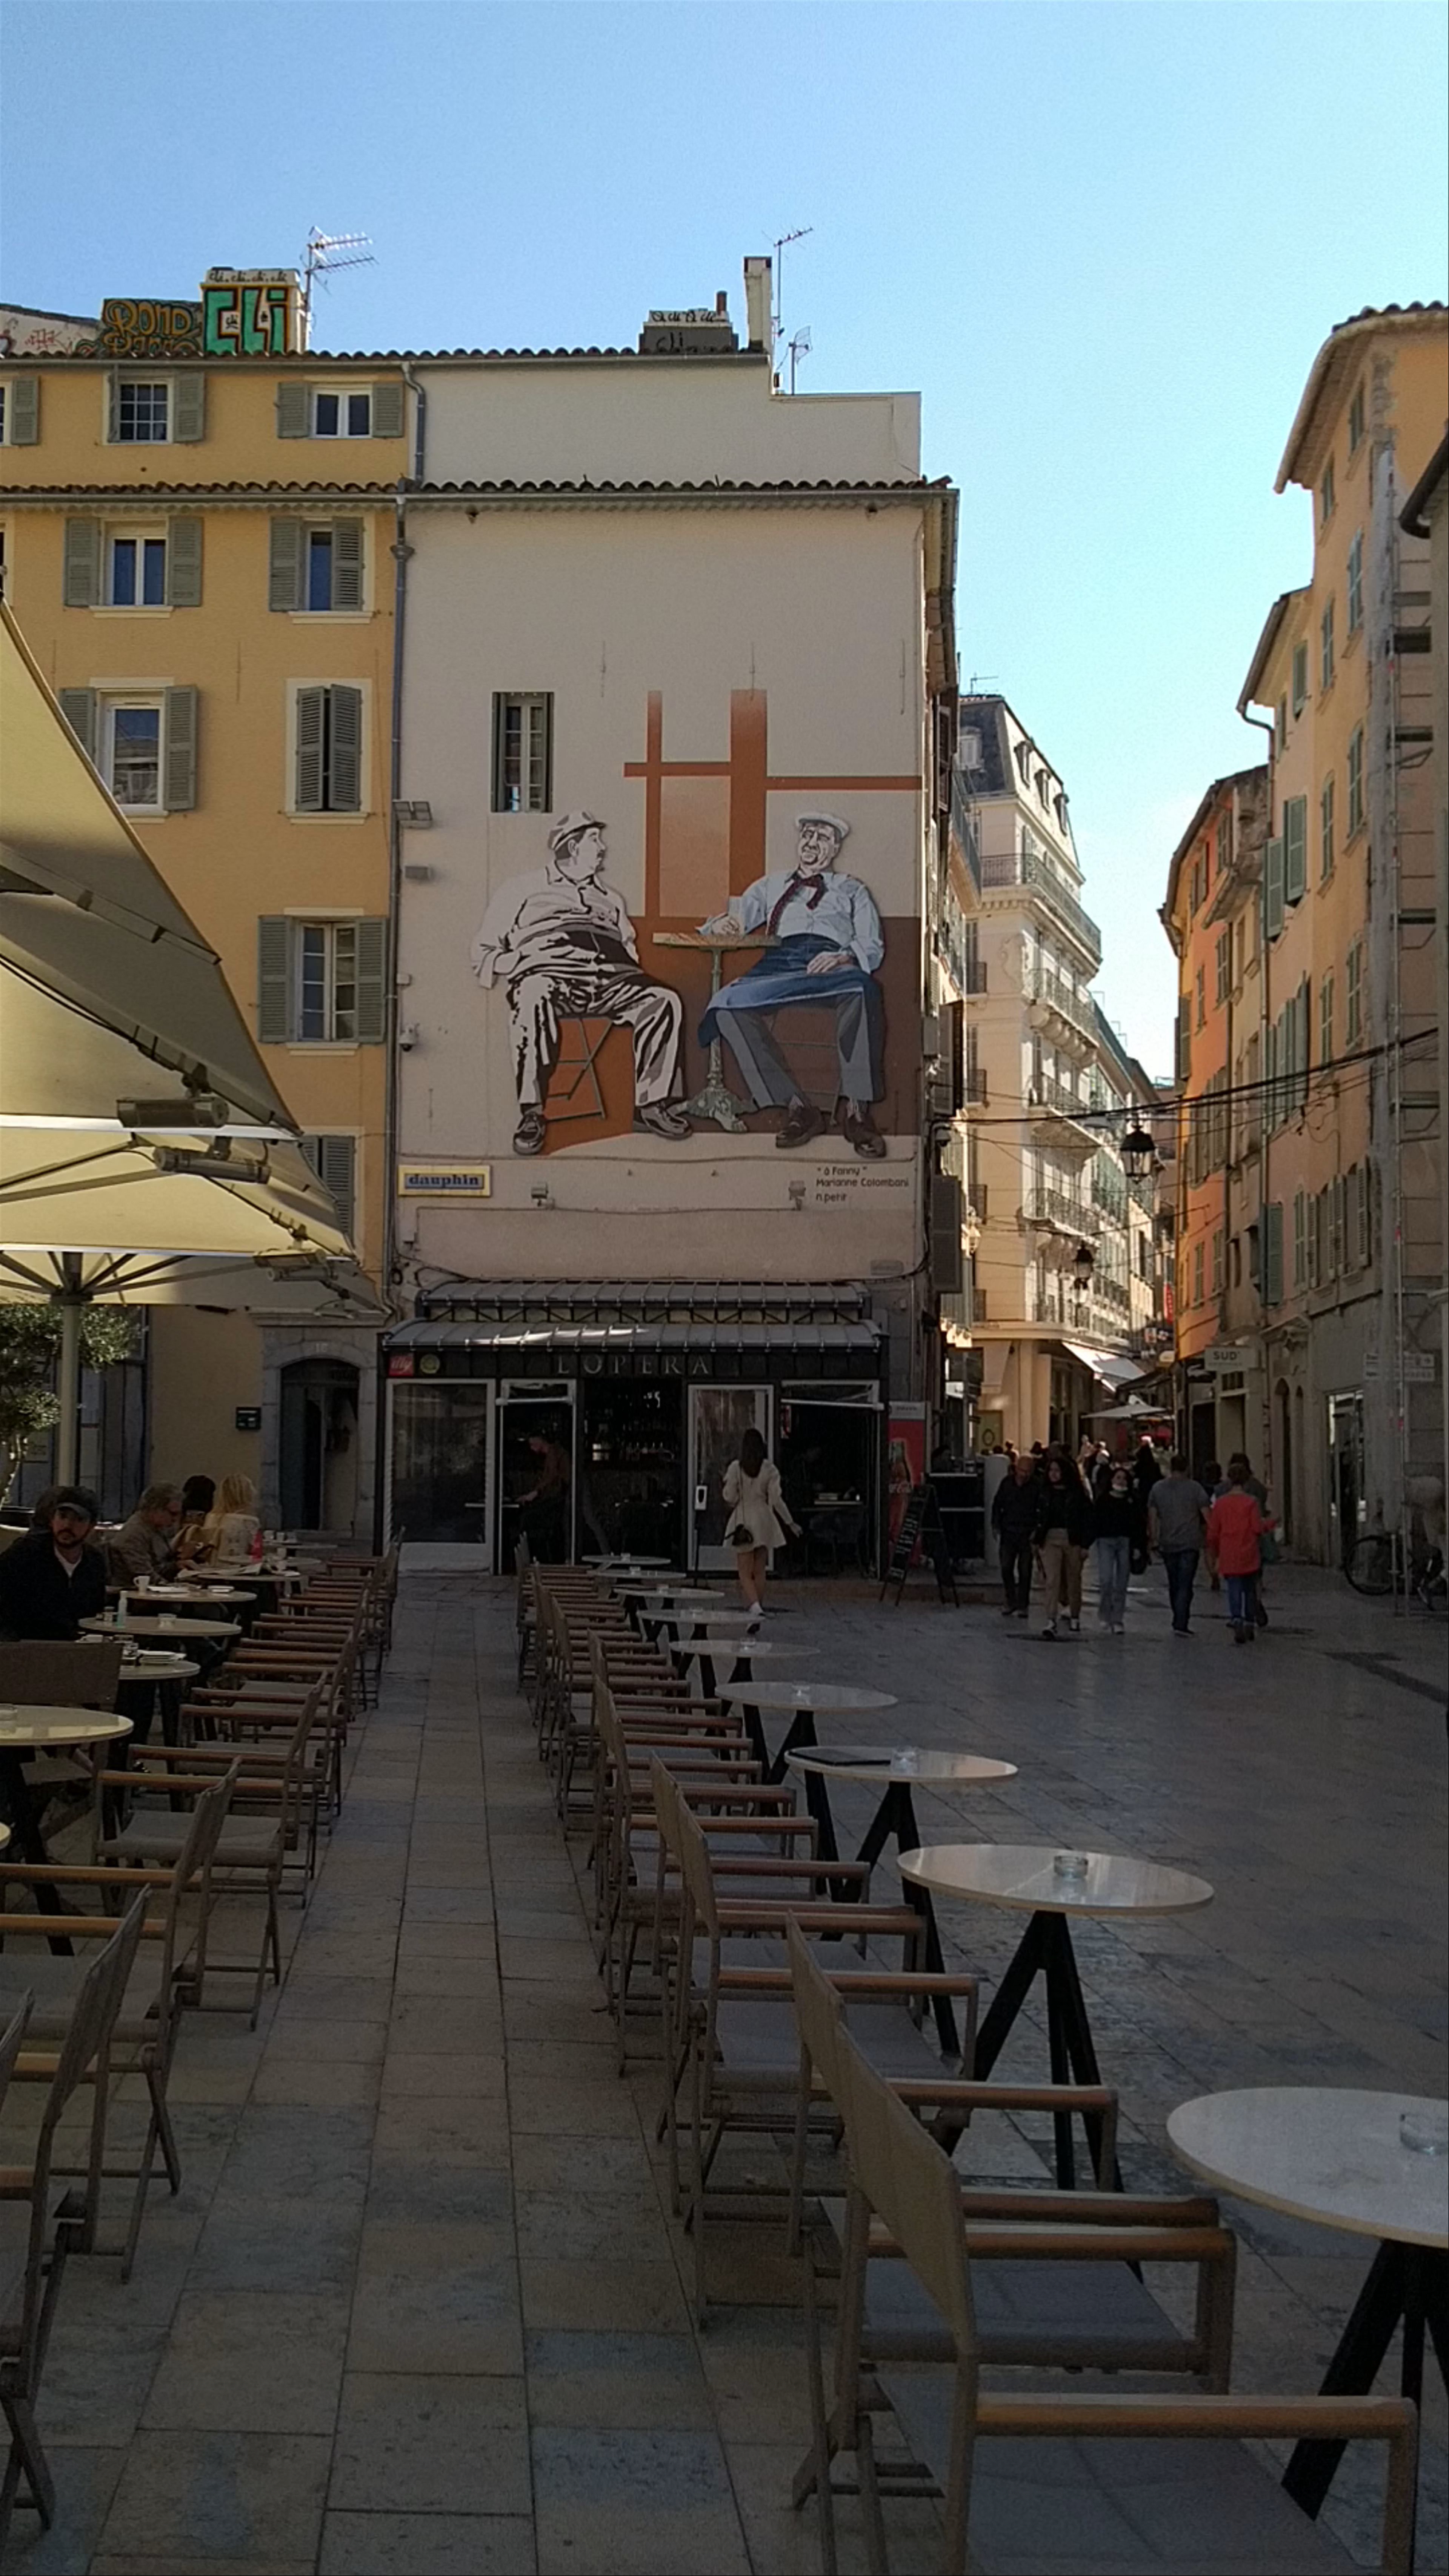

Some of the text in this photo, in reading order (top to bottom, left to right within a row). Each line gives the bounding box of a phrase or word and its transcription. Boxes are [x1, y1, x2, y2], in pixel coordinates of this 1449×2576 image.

[832, 1166, 860, 1176] Fanny
[408, 1174, 479, 1187] dauphin
[816, 1178, 909, 1187] Marianne Colombani
